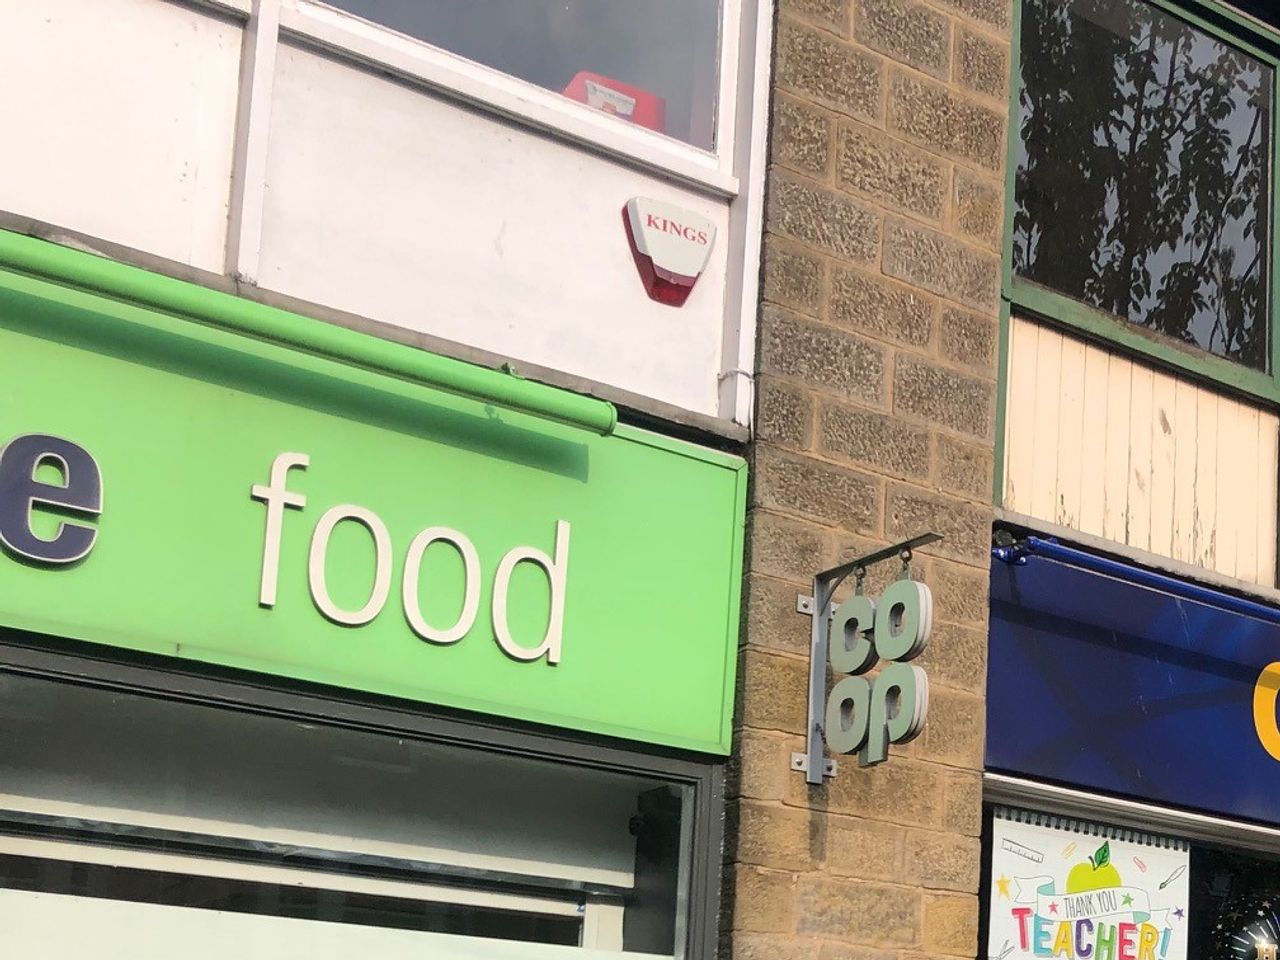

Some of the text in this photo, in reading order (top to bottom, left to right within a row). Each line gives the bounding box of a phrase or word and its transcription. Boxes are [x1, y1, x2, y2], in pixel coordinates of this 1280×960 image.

[646, 213, 708, 245] KINGS
[252, 452, 570, 666] food
[1064, 890, 1119, 919] THANK YOU
